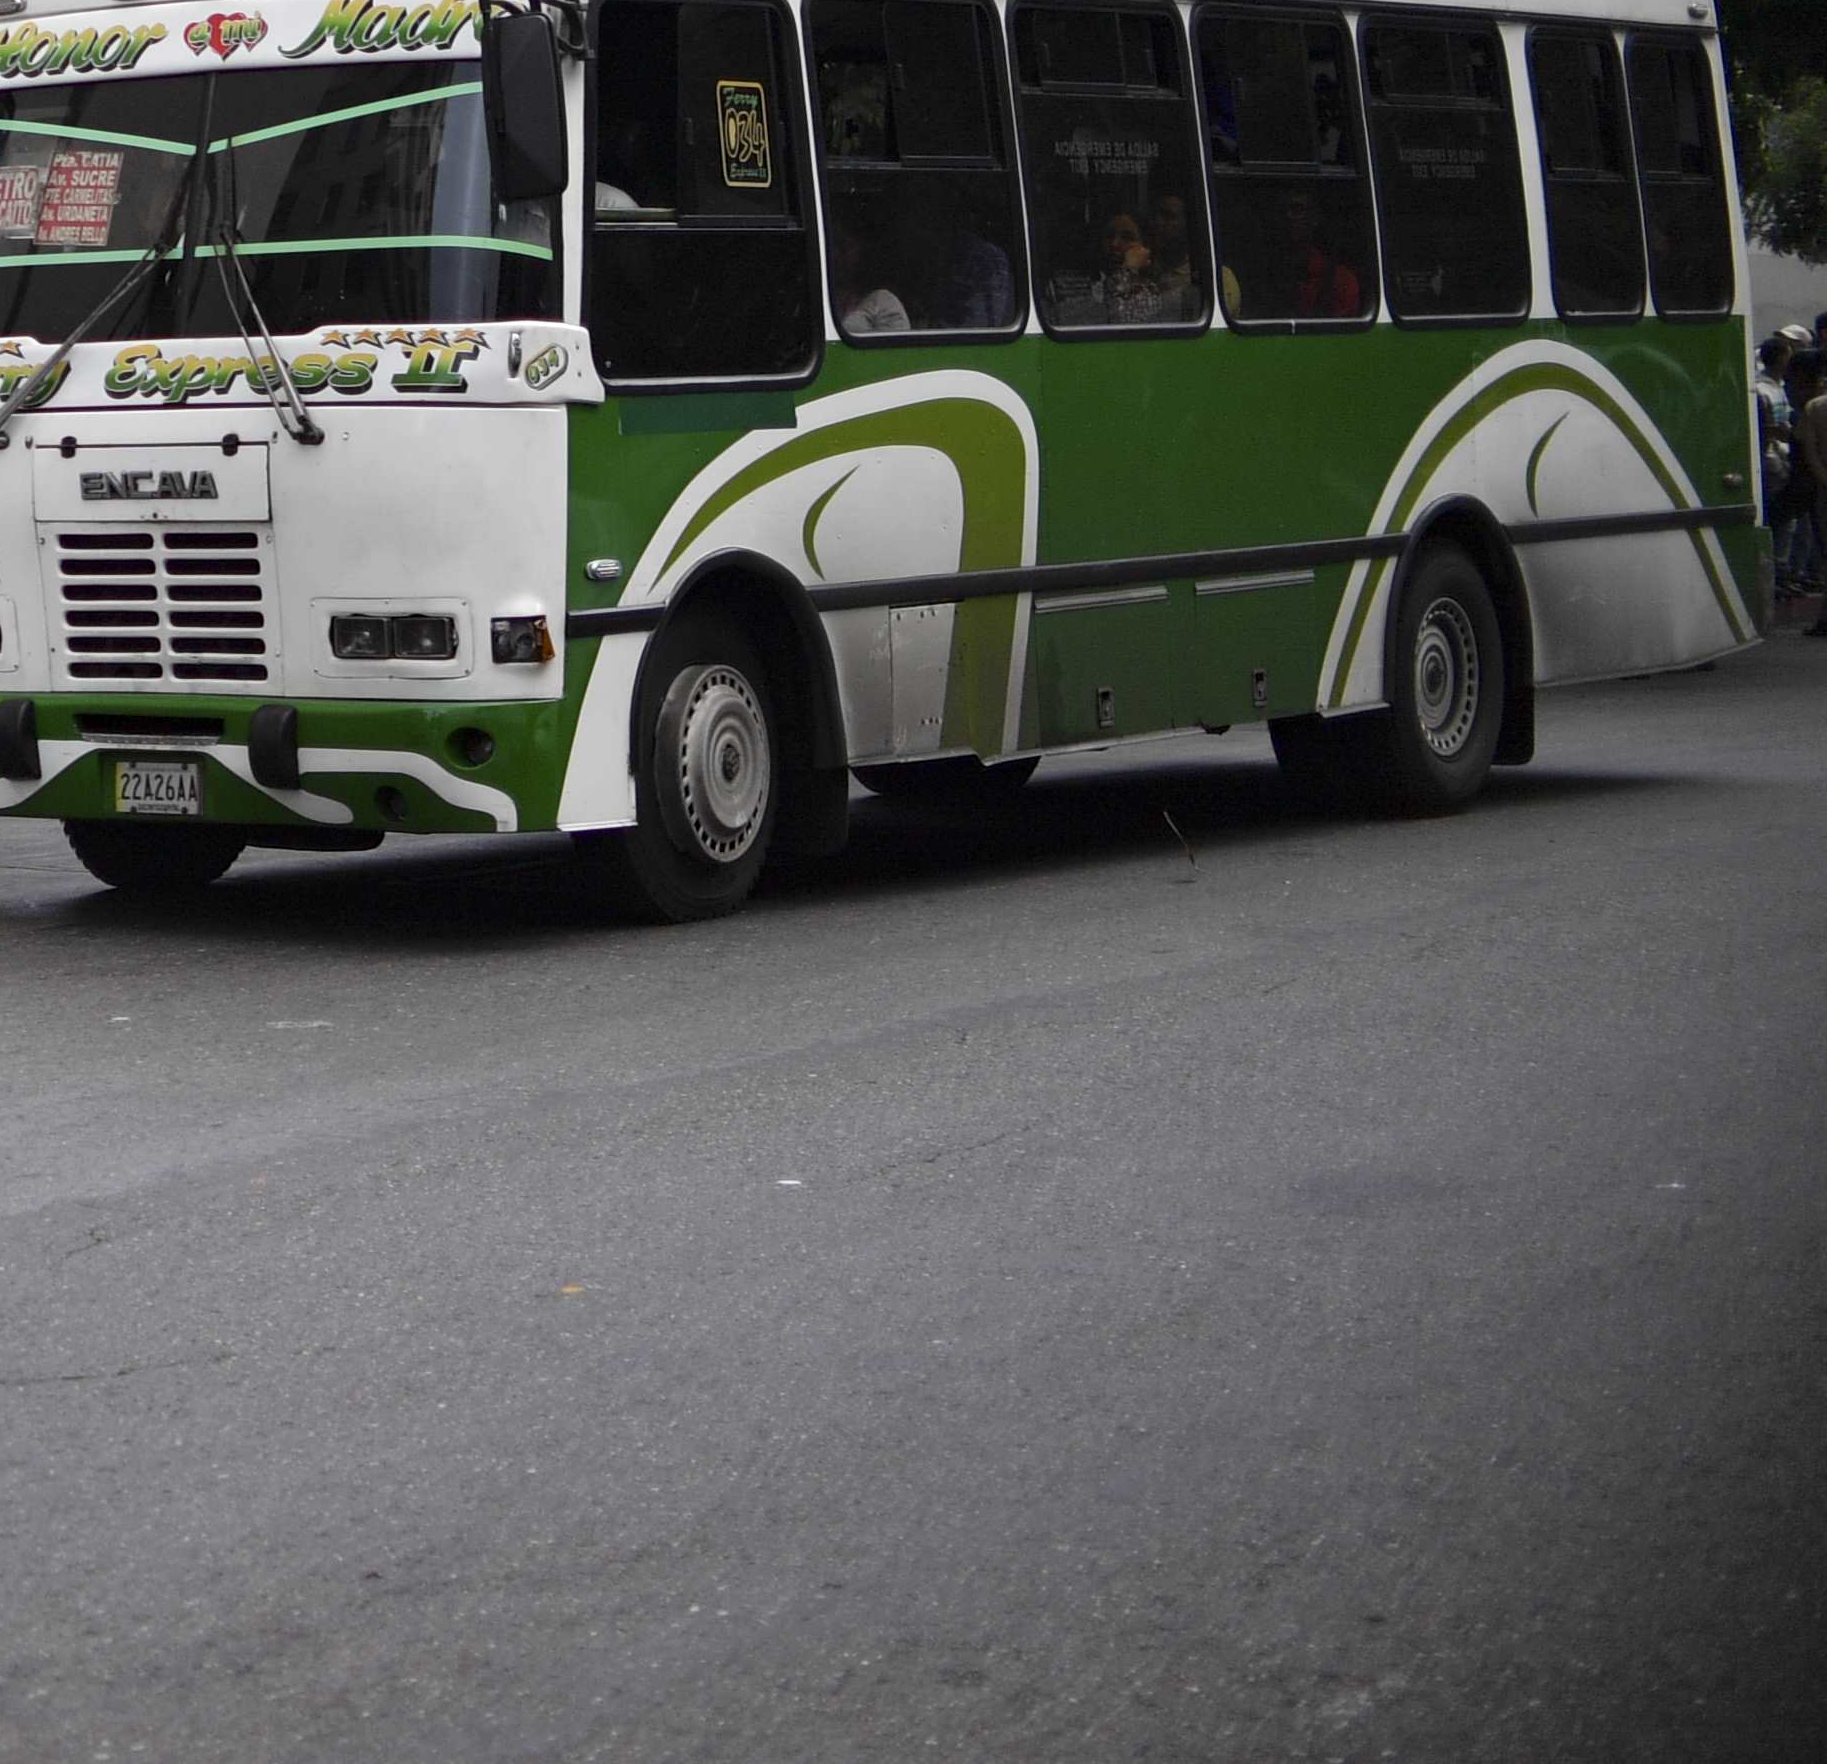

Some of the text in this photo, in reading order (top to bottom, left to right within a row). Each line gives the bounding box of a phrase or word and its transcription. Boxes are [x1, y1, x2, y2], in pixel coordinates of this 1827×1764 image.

[188, 21, 210, 48] a
[220, 10, 265, 46] mi
[725, 107, 766, 167] 034
[81, 151, 120, 168] CATIA
[48, 170, 116, 186] Av. SUCRE
[104, 344, 378, 404] Express
[390, 342, 480, 393] II
[79, 470, 219, 501] ENCAVA
[120, 772, 198, 803] 22A26AA
